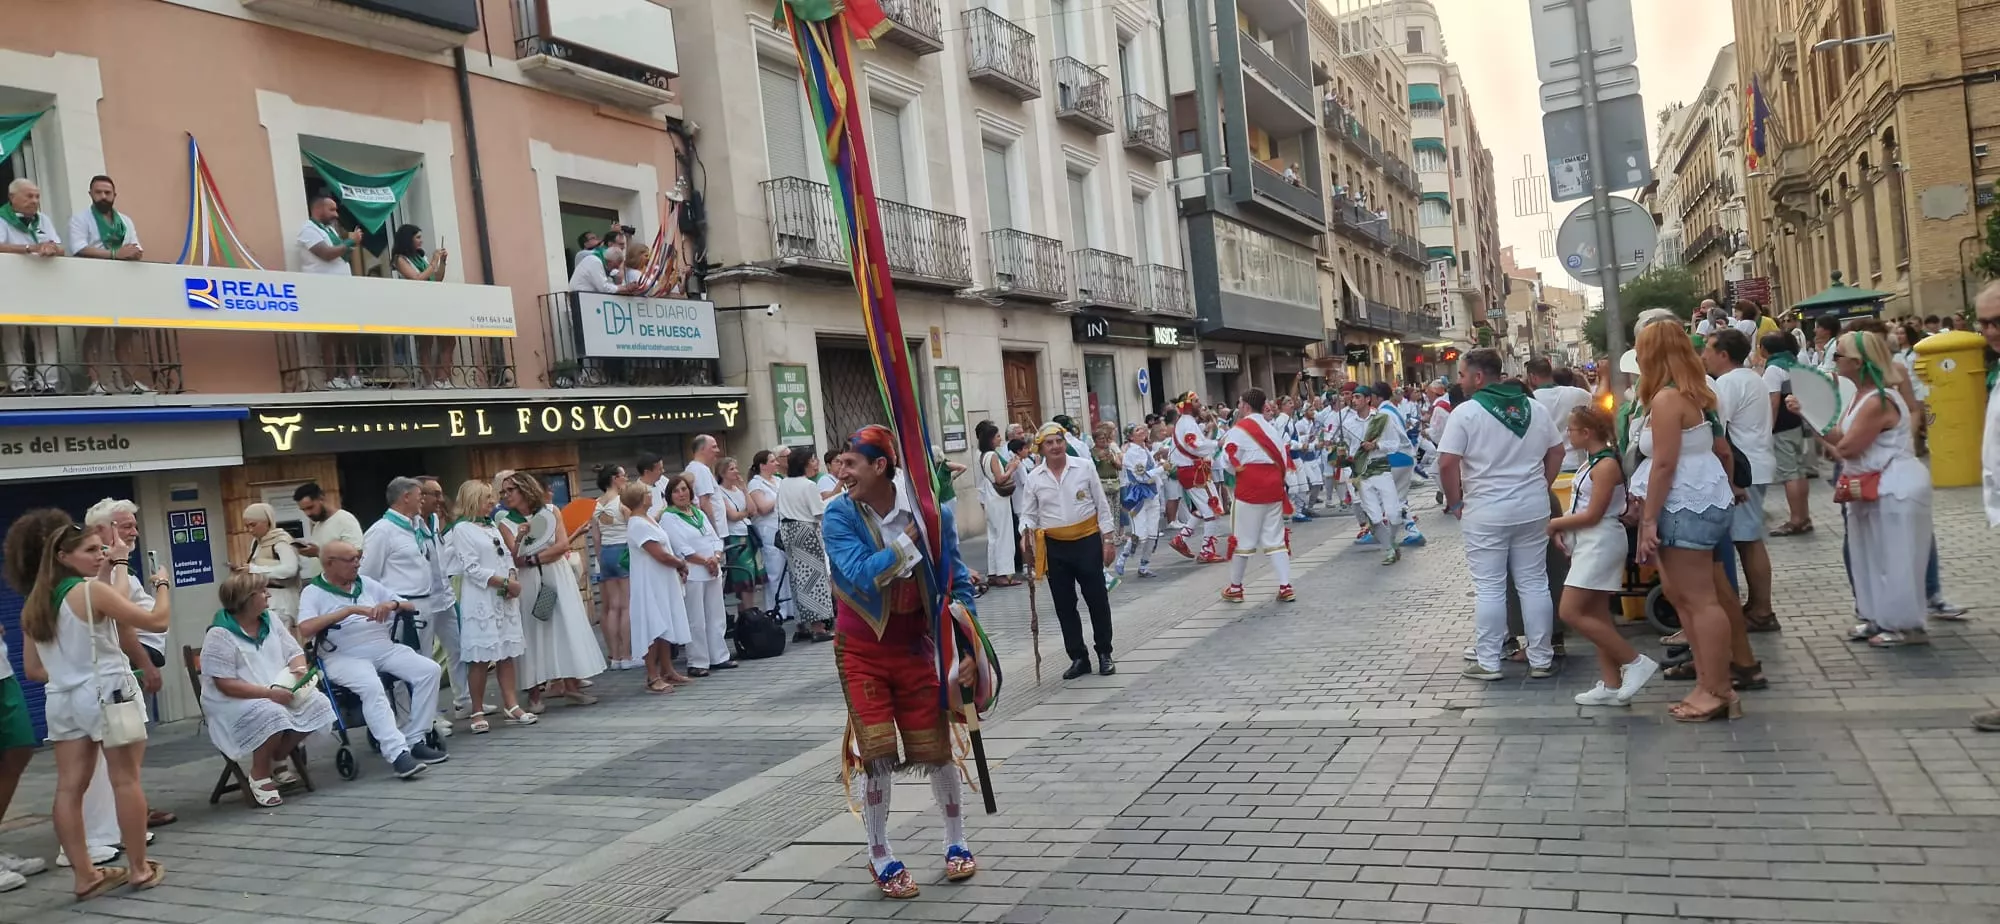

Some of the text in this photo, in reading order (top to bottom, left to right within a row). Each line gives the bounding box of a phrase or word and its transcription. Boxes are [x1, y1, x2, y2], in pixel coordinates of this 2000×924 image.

[221, 280, 297, 299] REALE
[1438, 262, 1450, 329] FARMACIA
[224, 298, 299, 312] SEGUROS
[636, 302, 698, 320] EL DIARIO
[639, 323, 701, 339] DE HUESCA
[1087, 321, 1103, 338] IN
[1154, 326, 1178, 346] INSIDE
[616, 343, 693, 352] www.eldiariodehuesca.com
[338, 422, 420, 433] TABERNA
[448, 408, 493, 437] EL
[516, 404, 632, 434] FOSKO
[30, 436, 59, 453] del
[65, 433, 130, 452] Estado
[175, 567, 202, 577] Apuestas
[176, 577, 197, 585] Estado
